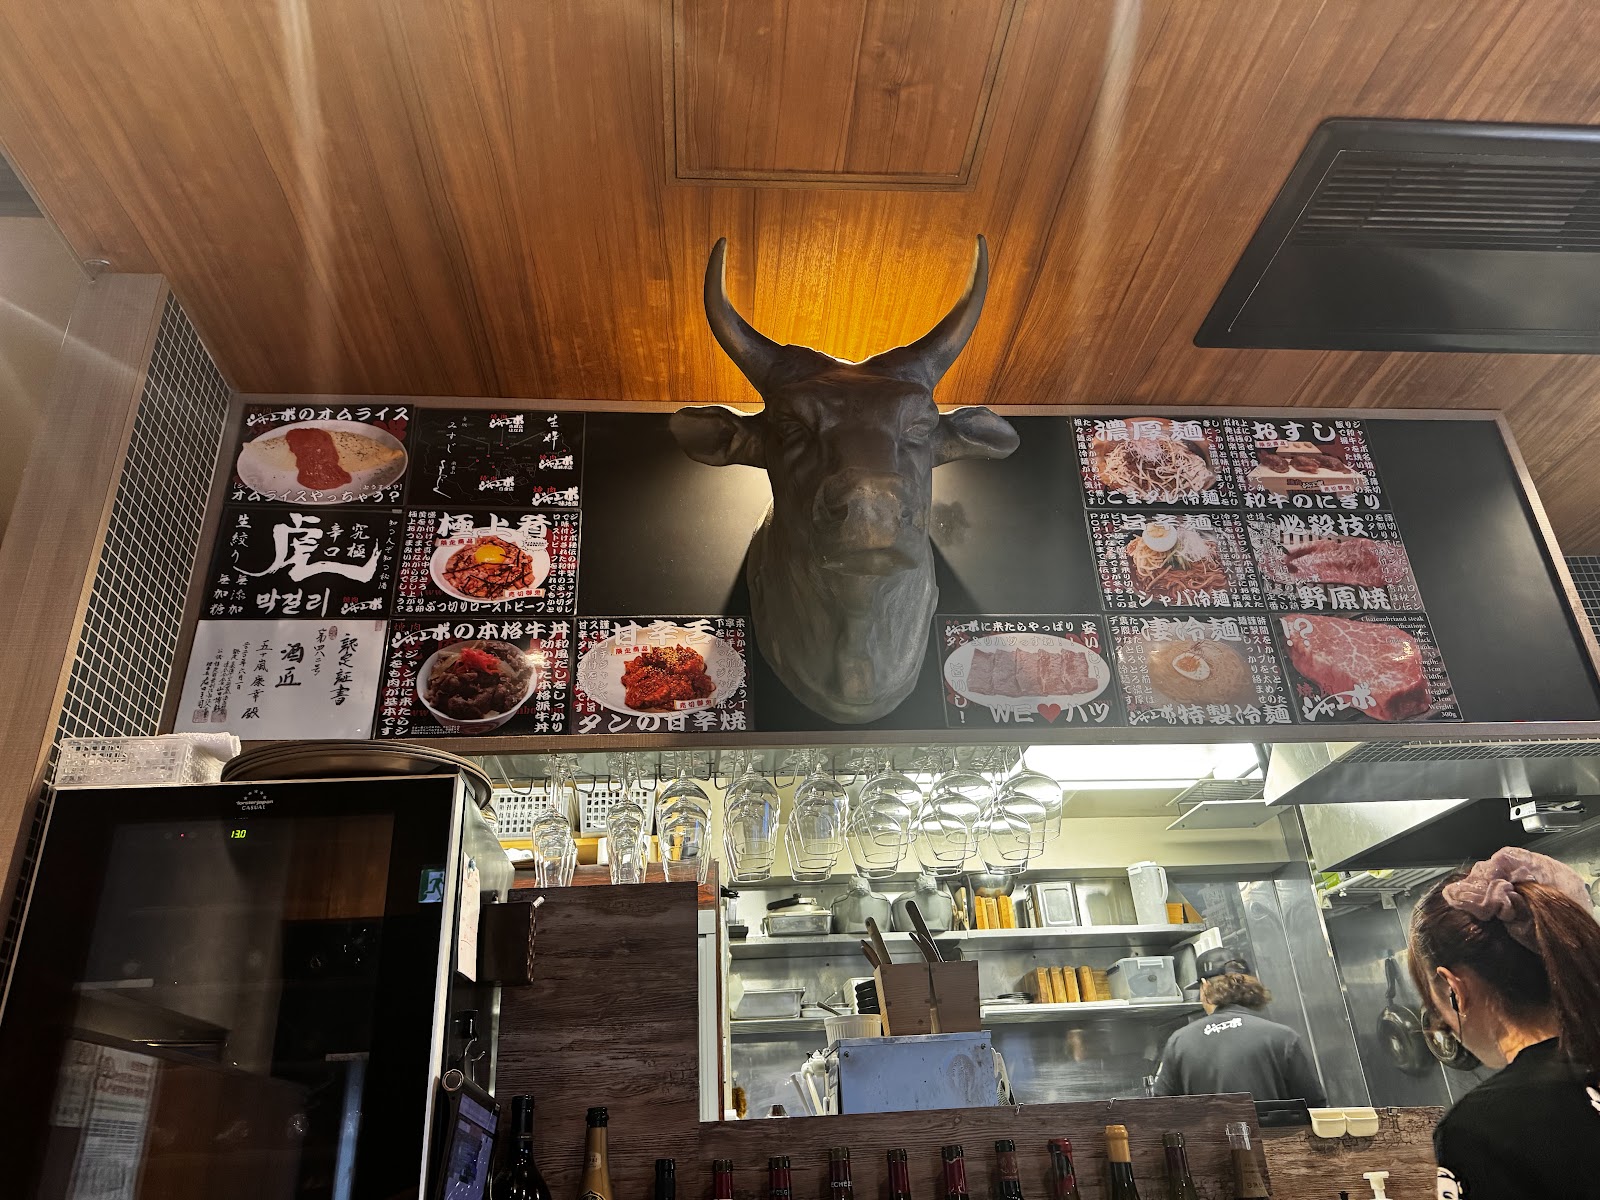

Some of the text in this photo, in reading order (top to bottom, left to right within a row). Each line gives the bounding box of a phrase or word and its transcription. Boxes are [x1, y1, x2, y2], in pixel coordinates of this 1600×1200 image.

[446, 422, 457, 454] みすじ
[1093, 420, 1206, 442] 濃厚麺
[1251, 420, 1336, 442] おすし
[1107, 488, 1221, 506] ごまダレ冷麺
[1243, 492, 1380, 510] 和牛のにぎり
[1279, 513, 1370, 537] 必殺技
[323, 522, 344, 557] 辛口
[346, 523, 370, 559] 究極
[256, 587, 331, 618] 막걸리
[425, 601, 546, 613] ぶつ切りローストビーフ
[1296, 586, 1392, 611] 野原焼
[391, 620, 571, 648] ジャンボの本格牛丼
[394, 649, 419, 736] ジャンボに来たらシ
[551, 638, 570, 733] 和風だしをしっかり
[578, 709, 748, 734] タンの甘辛焼
[988, 702, 1110, 723] WE ハツ
